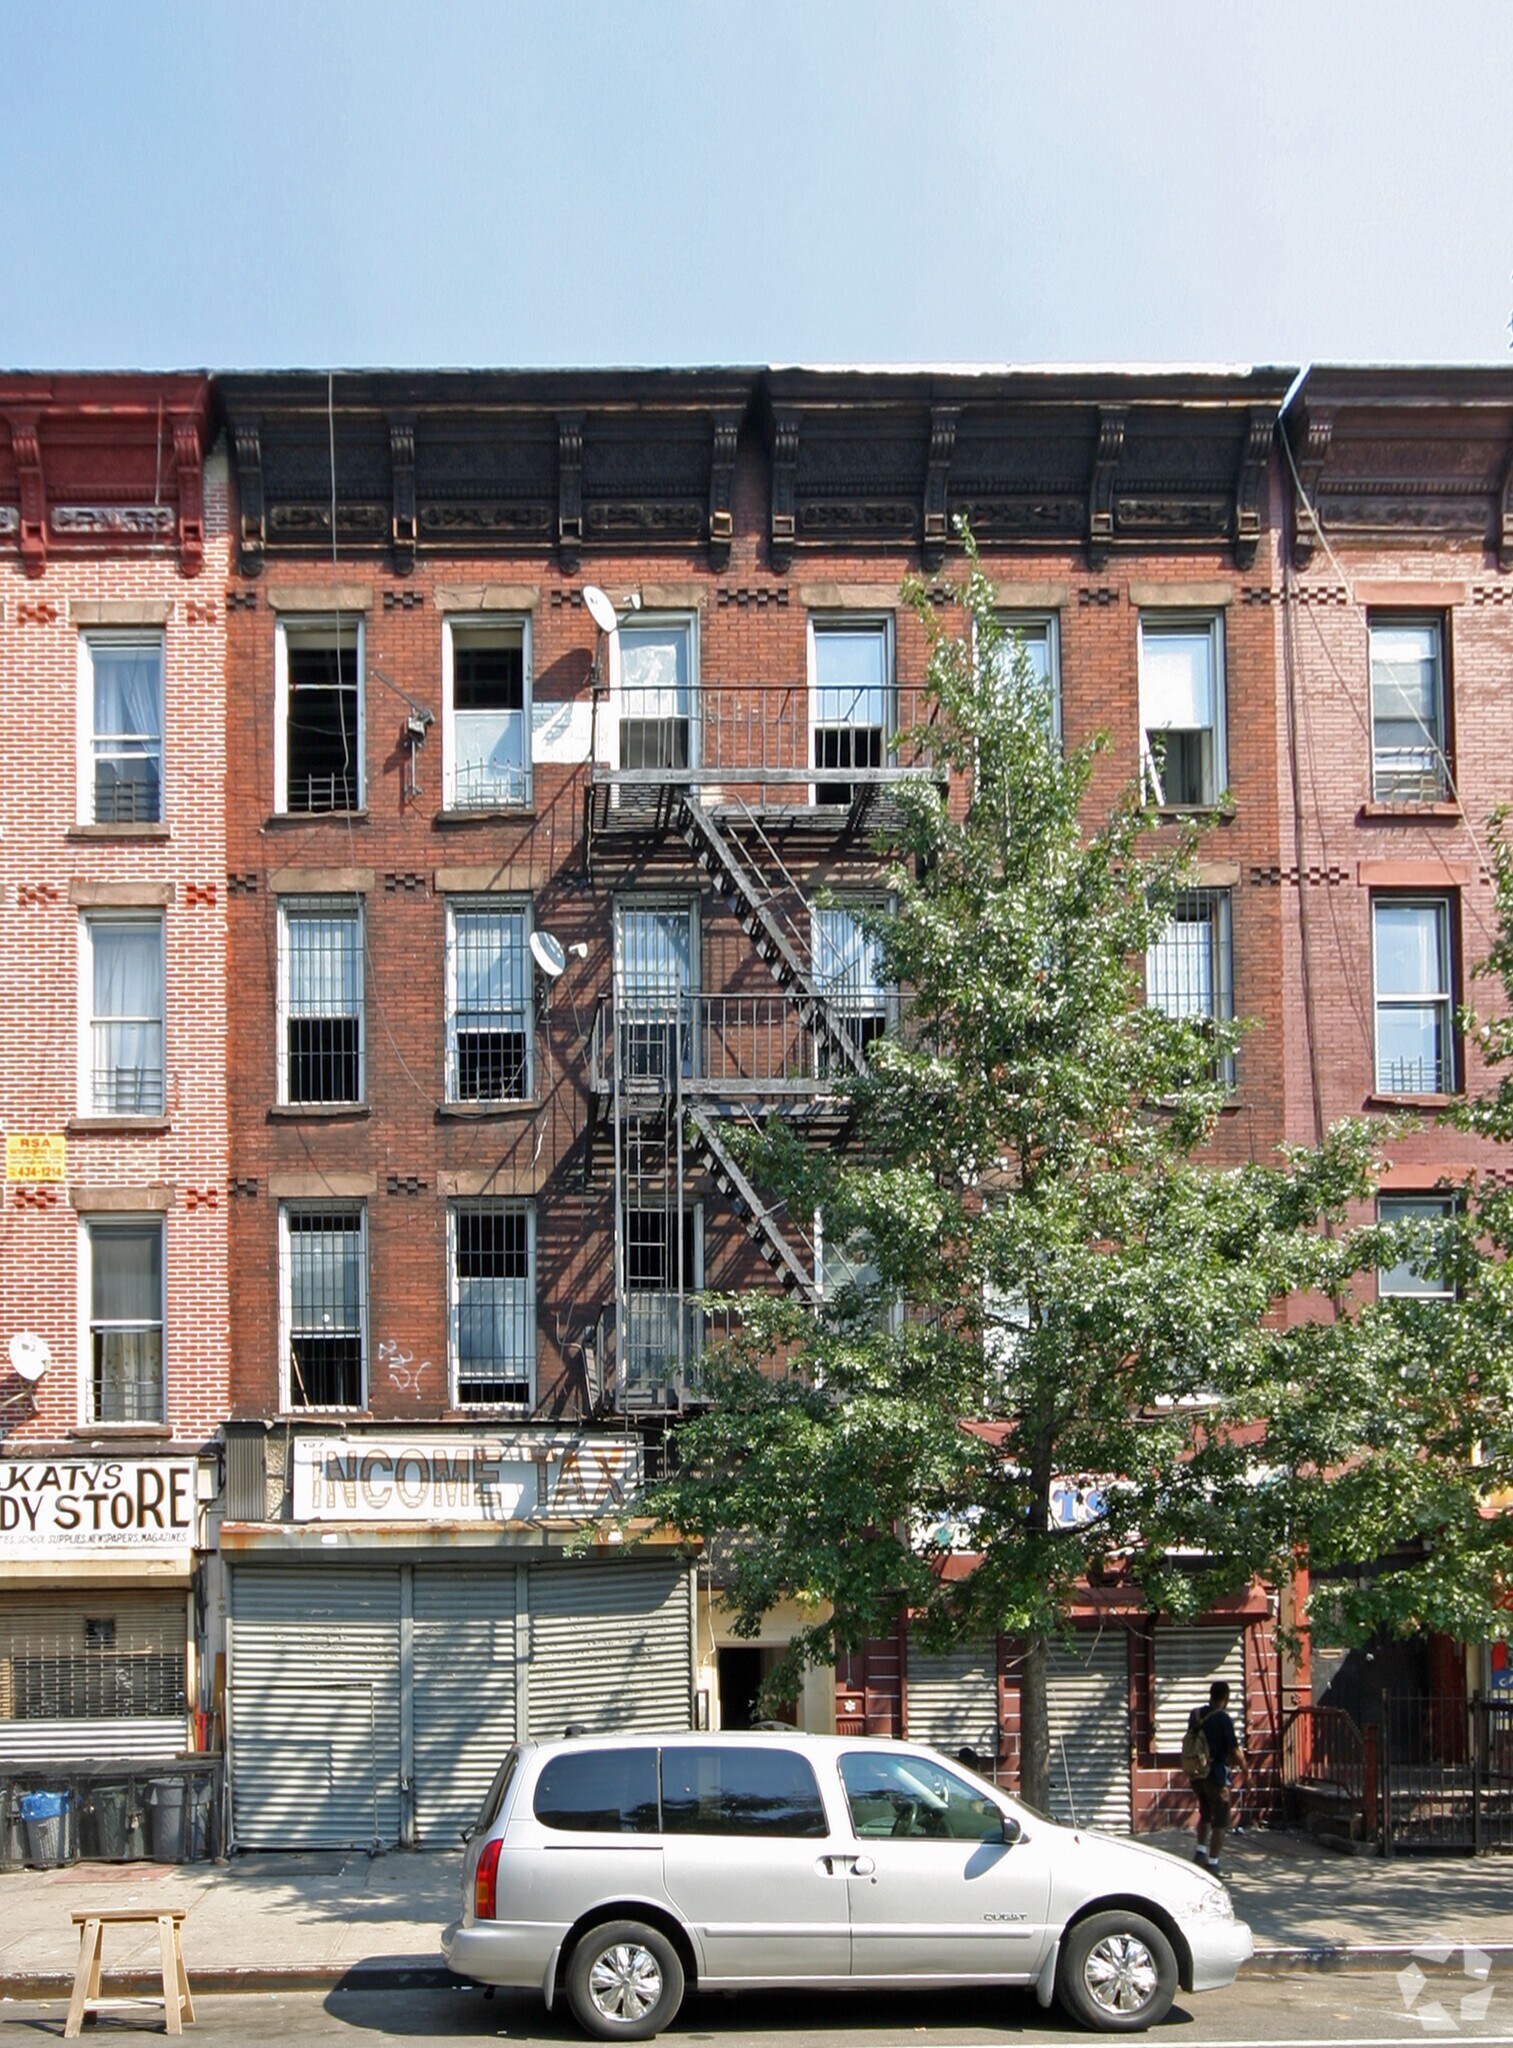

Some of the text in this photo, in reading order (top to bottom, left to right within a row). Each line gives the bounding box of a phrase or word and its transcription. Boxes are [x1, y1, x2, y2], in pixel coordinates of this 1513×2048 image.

[20, 1138, 51, 1148] RSA
[54, 1467, 191, 1531] STORE
[312, 1446, 626, 1509] INCOME TAX
